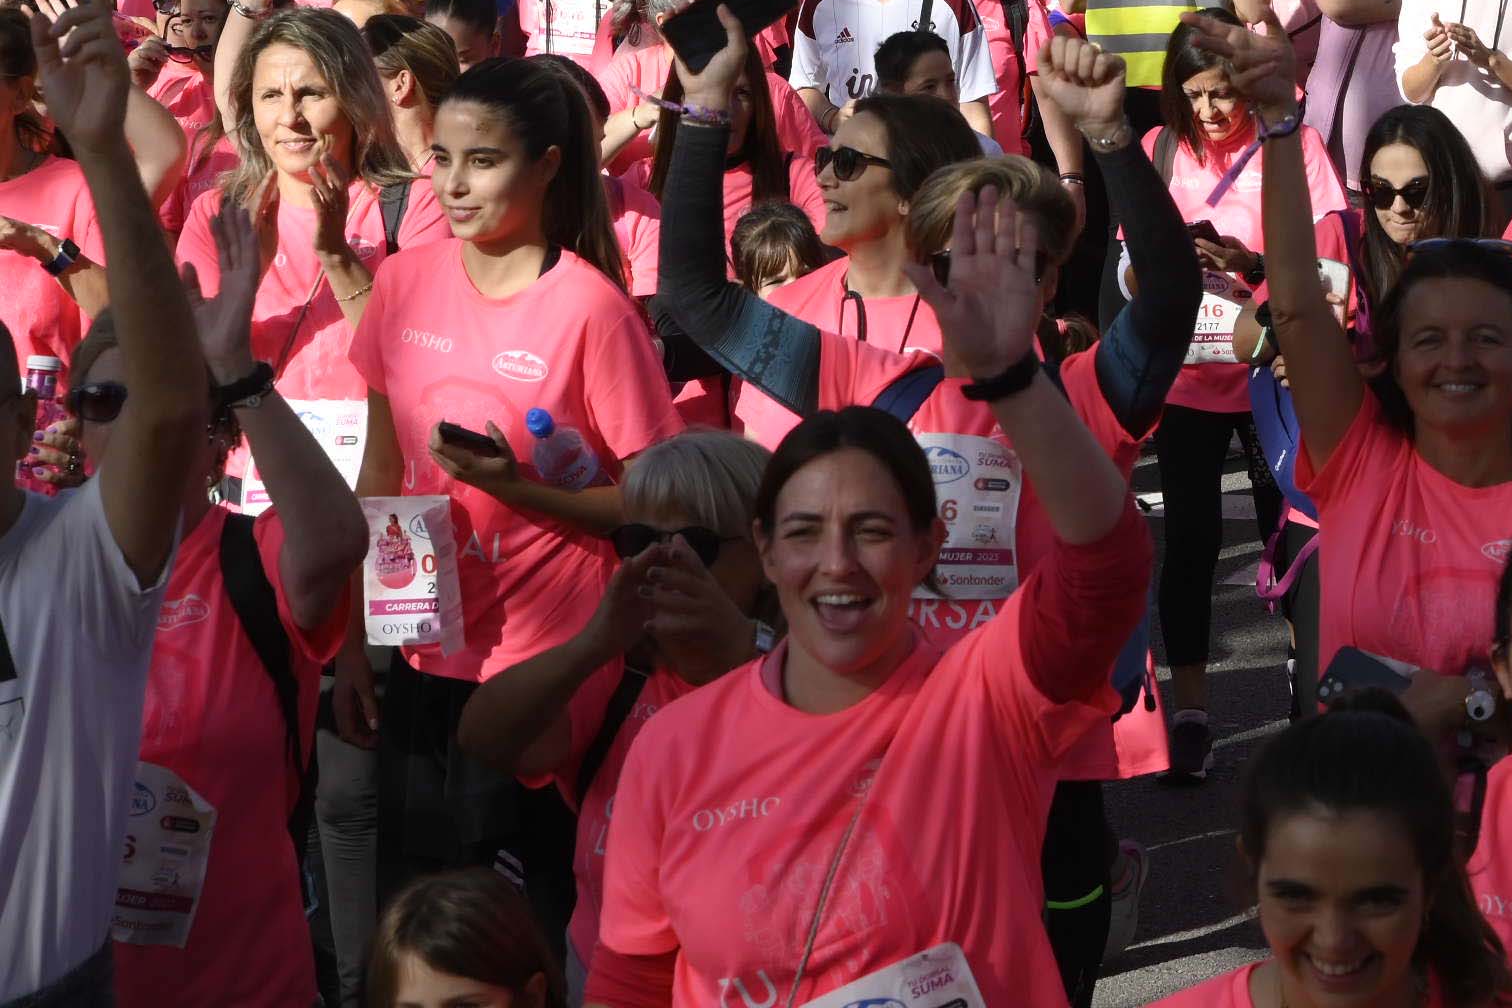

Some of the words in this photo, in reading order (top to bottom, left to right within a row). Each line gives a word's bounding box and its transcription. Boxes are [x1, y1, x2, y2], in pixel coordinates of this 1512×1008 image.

[1200, 303, 1225, 318] 16
[401, 327, 454, 353] OYSHO
[1213, 334, 1234, 342] MUJE
[940, 499, 958, 522] 6
[1392, 519, 1438, 545] YSHO
[461, 529, 507, 564] AL
[939, 551, 973, 561] MUJER
[427, 581, 436, 594] 2
[950, 574, 1006, 586] Santander
[385, 602, 431, 612] CARRERA
[908, 600, 997, 630] RSA
[382, 622, 432, 635] OYSHO
[911, 972, 955, 1000] SUMA
